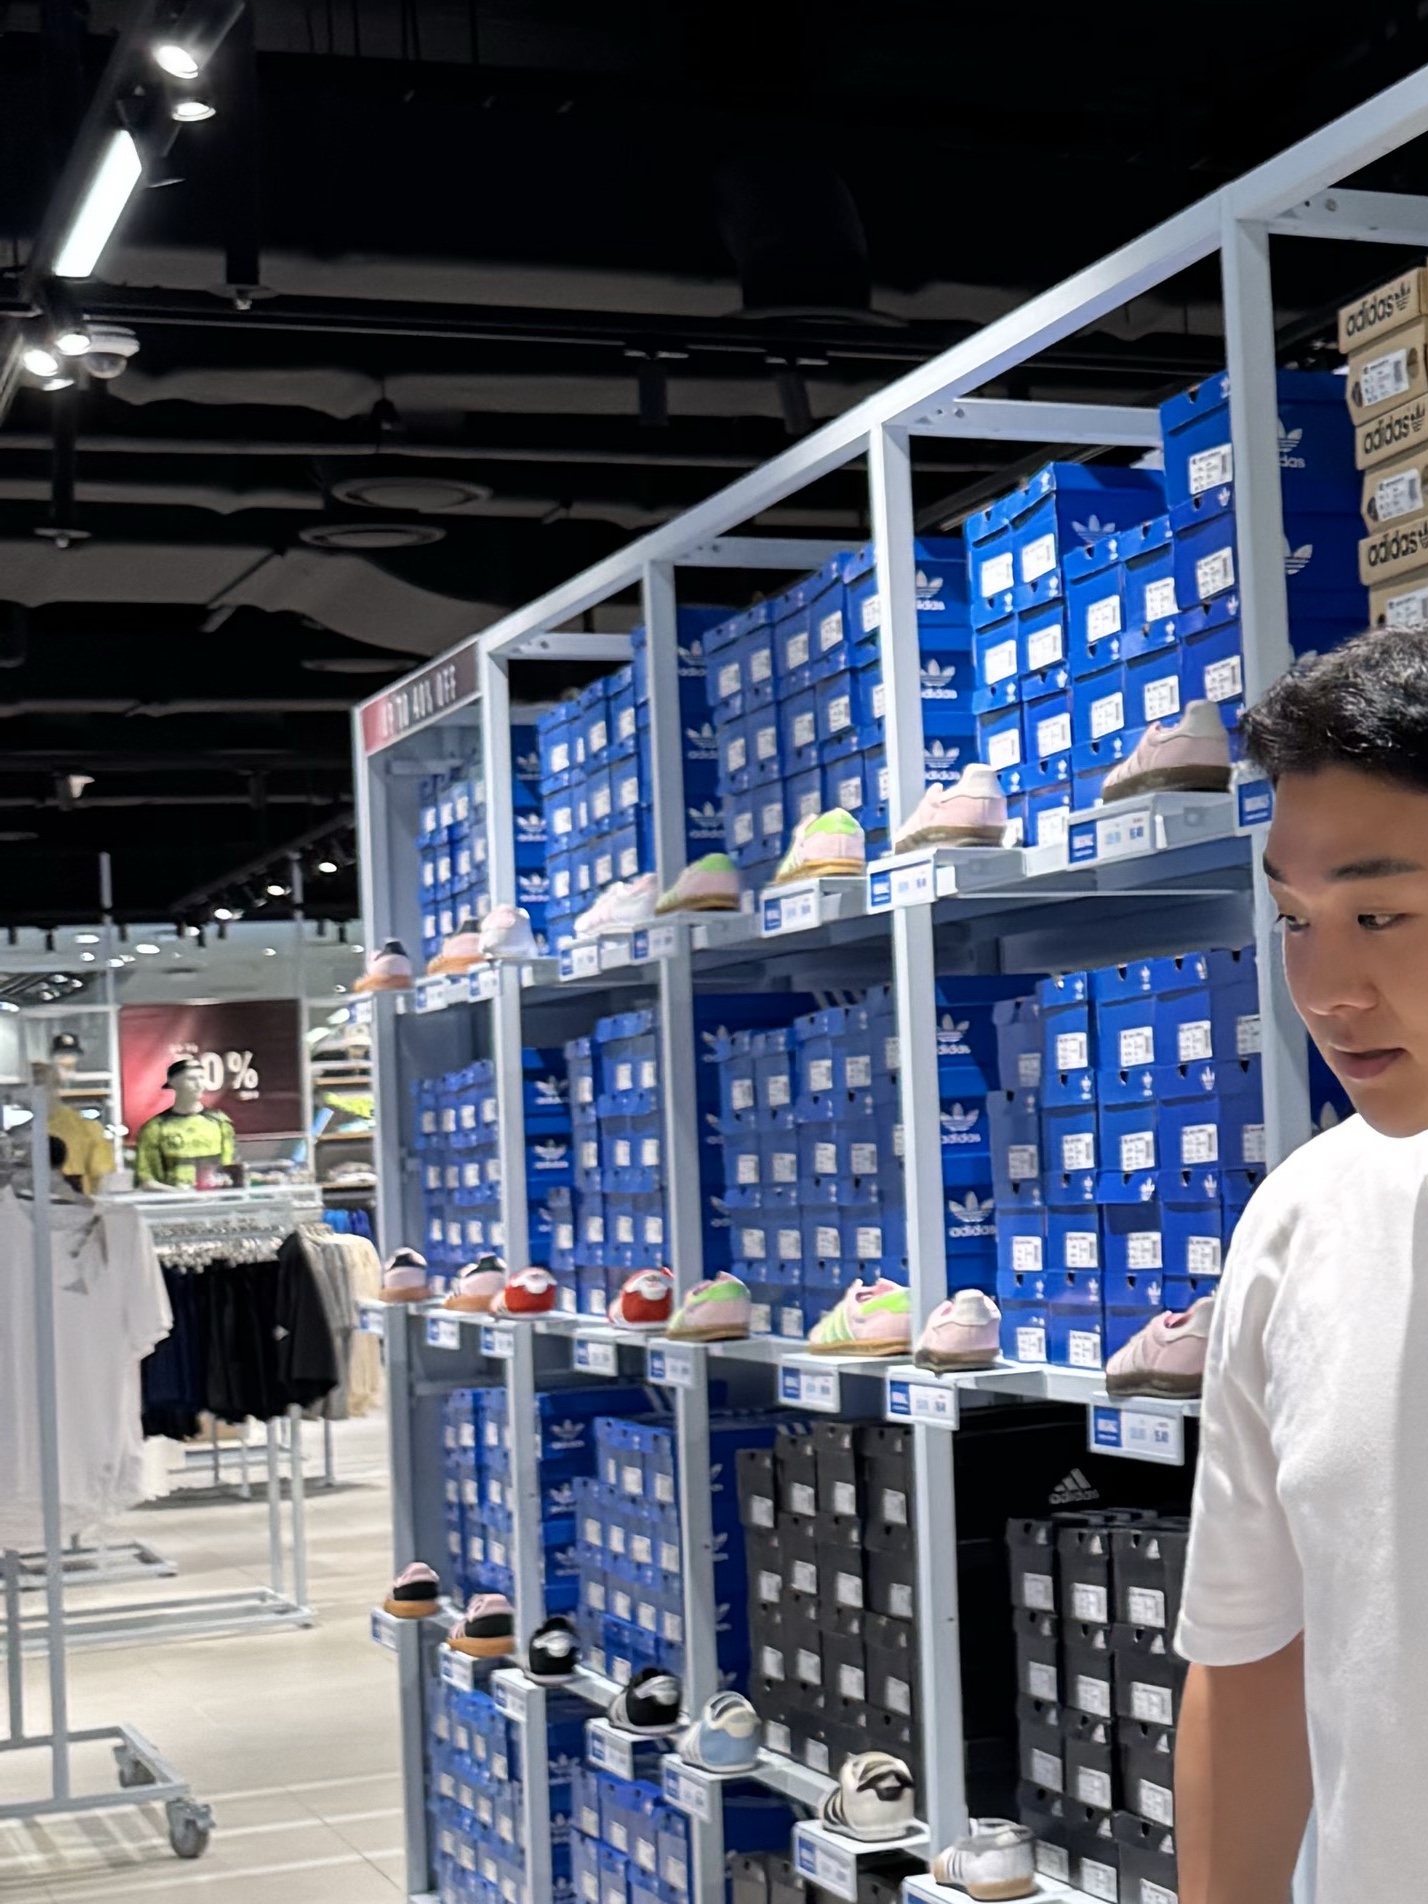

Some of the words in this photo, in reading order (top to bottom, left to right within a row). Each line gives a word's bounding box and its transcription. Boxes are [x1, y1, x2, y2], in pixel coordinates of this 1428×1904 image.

[1347, 294, 1394, 337] adidas
[1364, 412, 1410, 454] adidas
[1368, 529, 1418, 567] adidas
